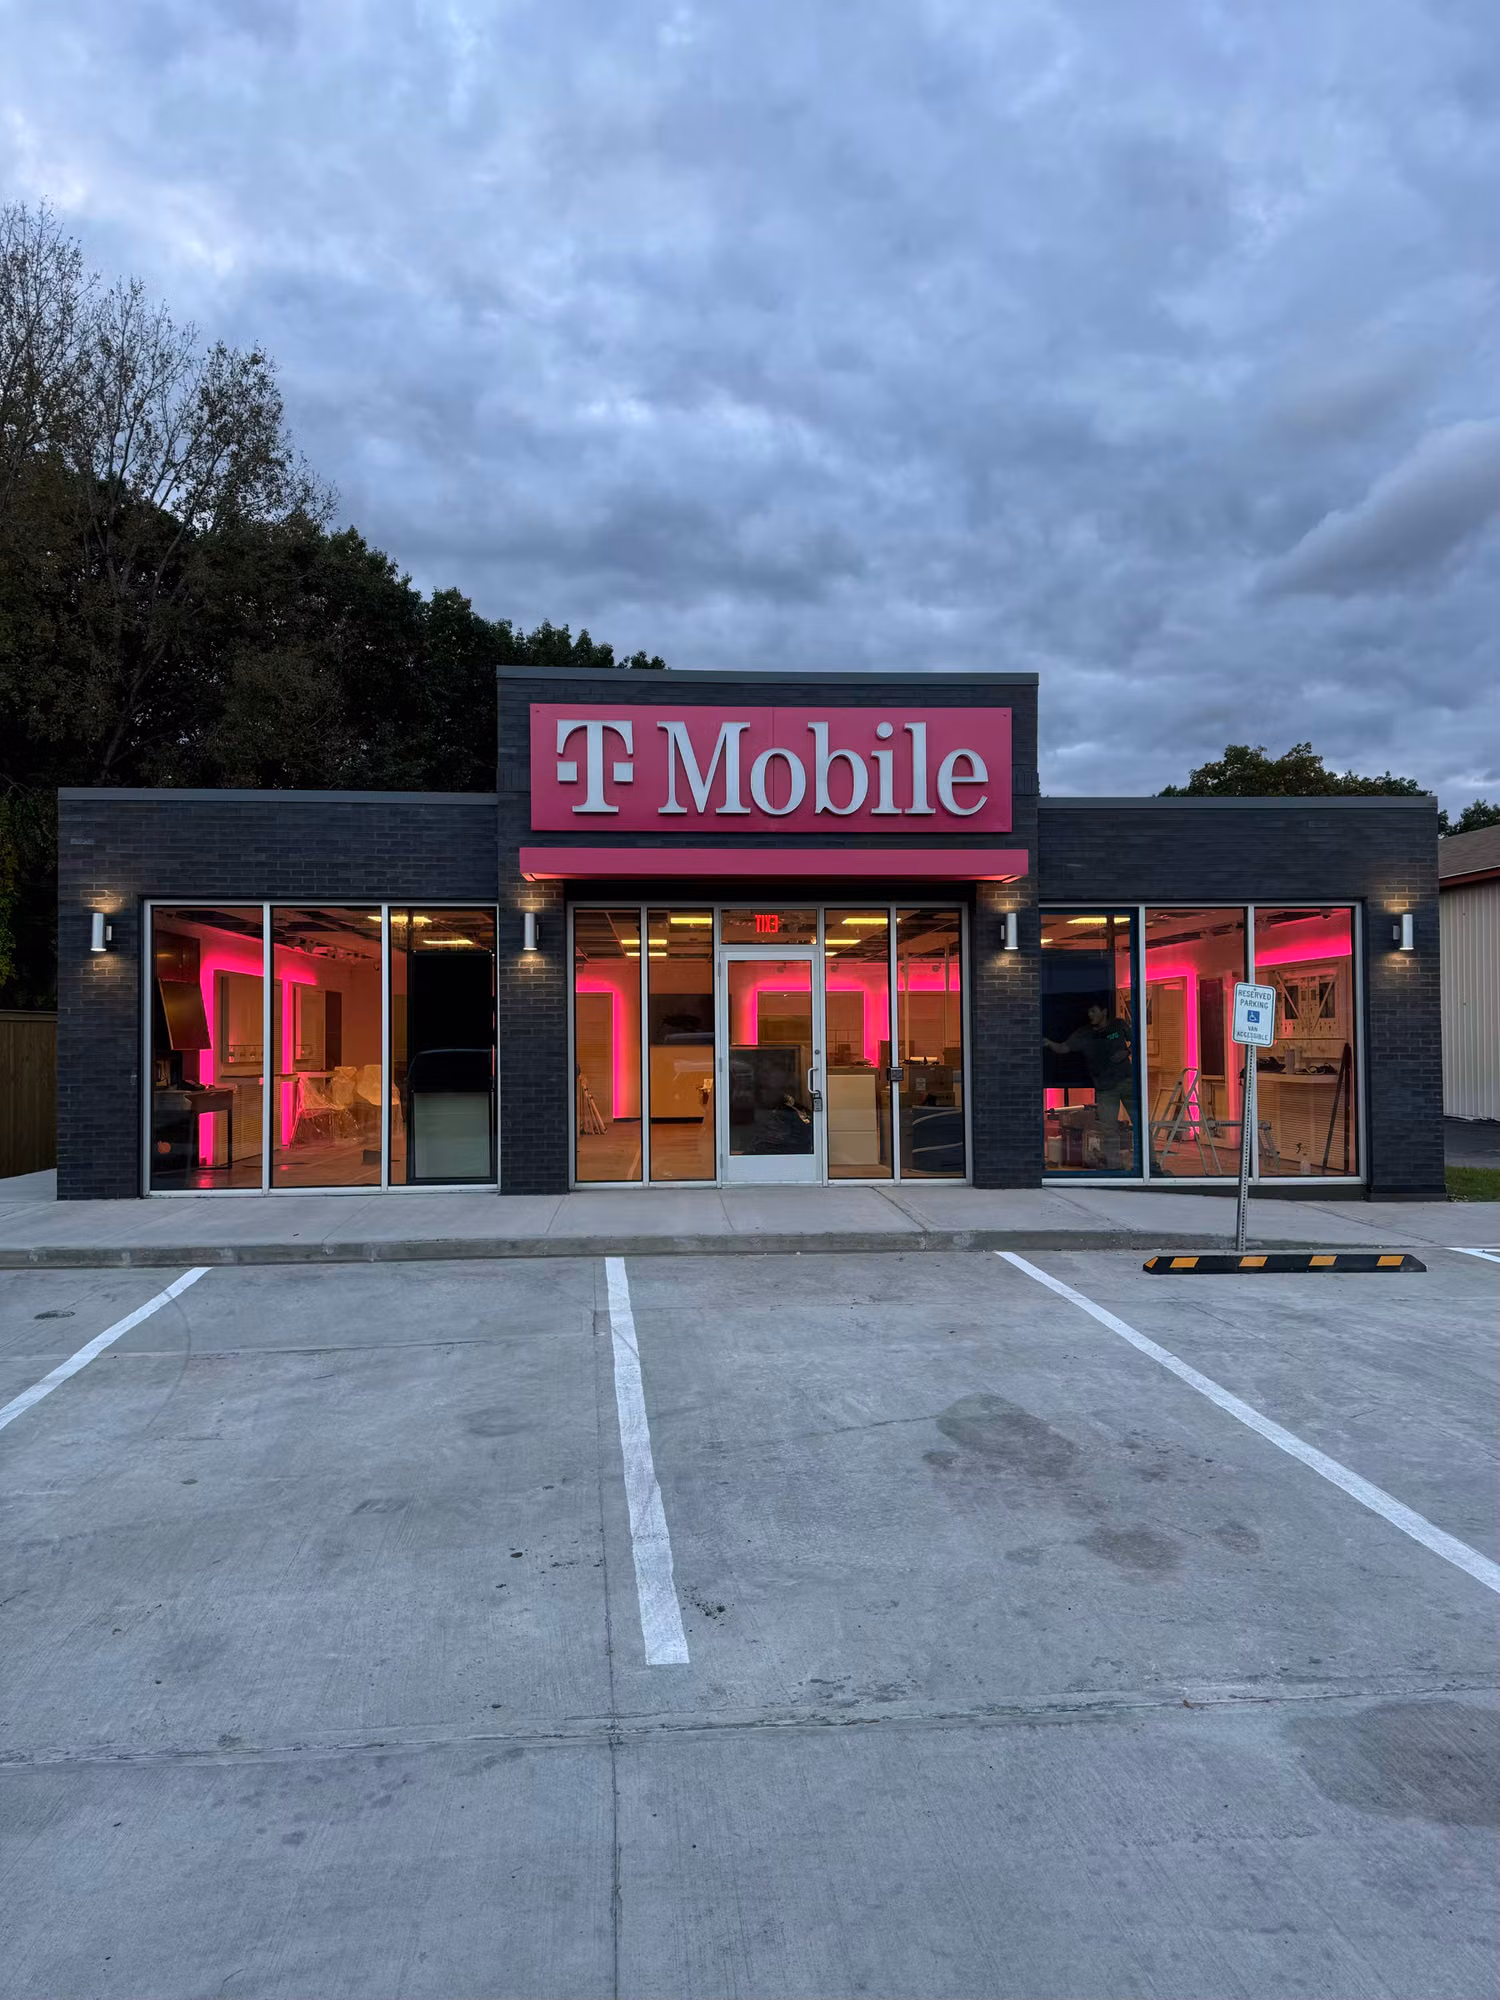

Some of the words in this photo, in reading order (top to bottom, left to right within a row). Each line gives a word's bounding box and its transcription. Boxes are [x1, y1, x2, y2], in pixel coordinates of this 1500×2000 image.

[656, 720, 989, 816] Mobile
[1238, 989, 1272, 1001] RESERVED
[1240, 998, 1269, 1010] PARKING
[1237, 1031, 1269, 1041] ACCESSIBLE
